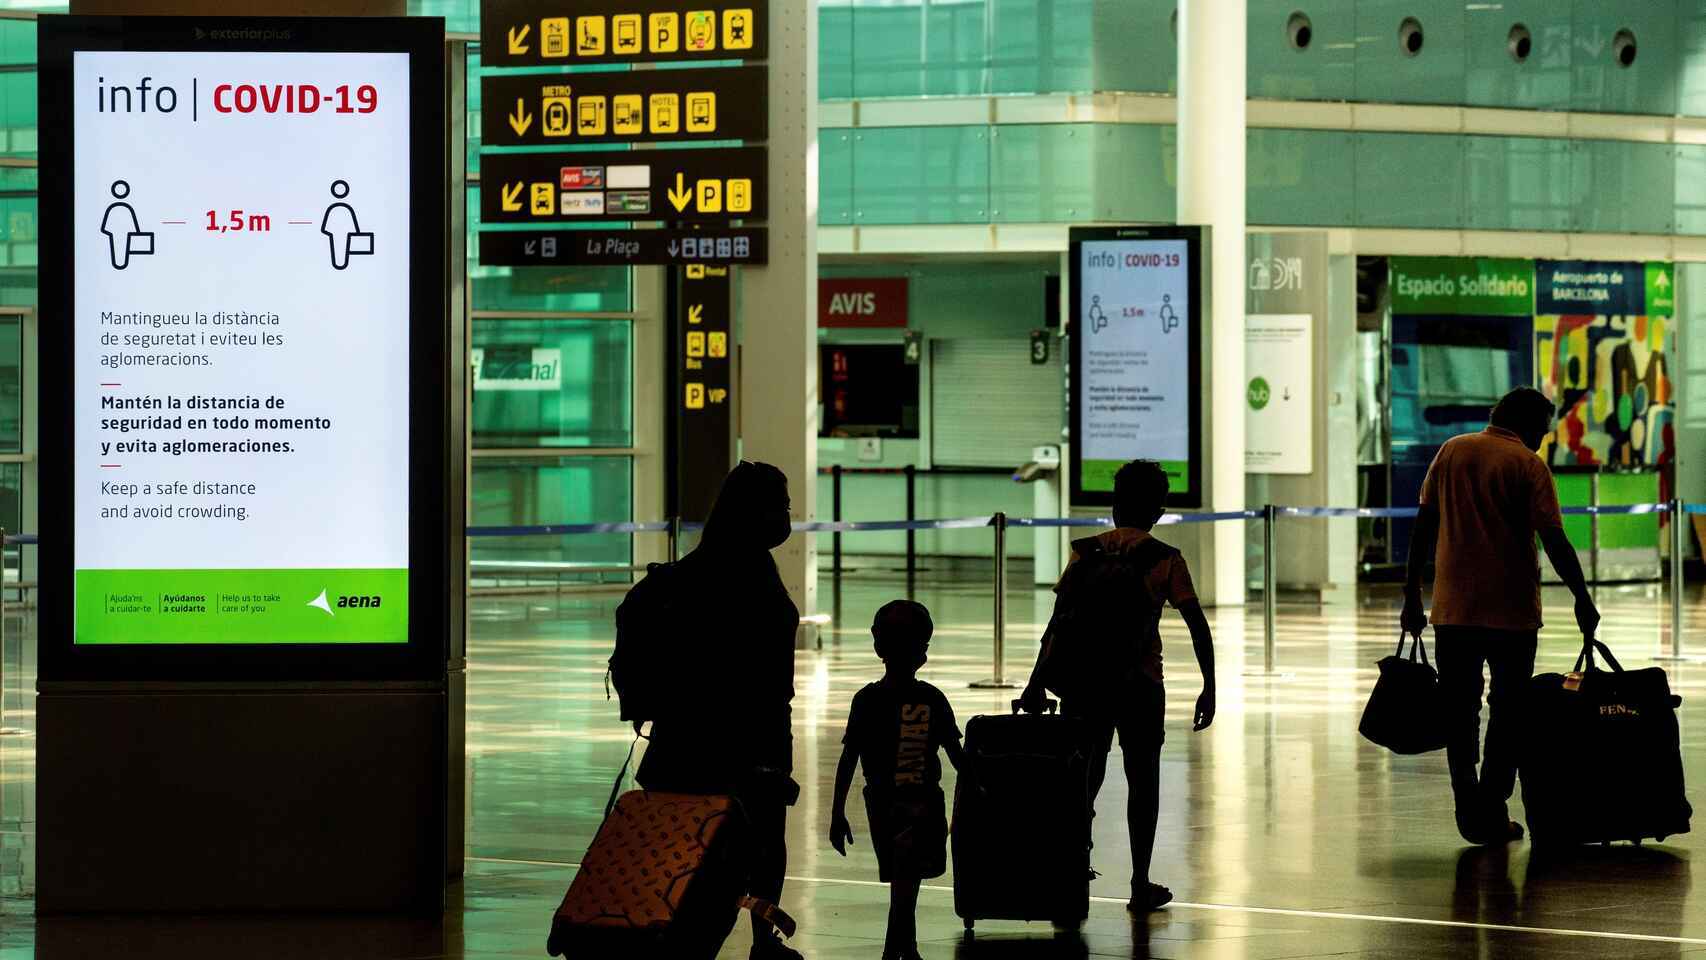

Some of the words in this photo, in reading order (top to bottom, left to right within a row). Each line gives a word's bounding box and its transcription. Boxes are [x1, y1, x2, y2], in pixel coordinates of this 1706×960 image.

[98, 77, 177, 113] info
[213, 84, 378, 114] COVID-19
[542, 85, 572, 98] METRO
[704, 186, 717, 208] P
[205, 210, 245, 234] 1,5
[249, 215, 271, 232] m
[586, 239, 602, 255] La
[605, 238, 640, 259] Plaça
[1087, 250, 1115, 268] info
[1125, 253, 1180, 268] COVID-19
[1610, 271, 1623, 284] de
[1397, 274, 1455, 301] Espacio
[1459, 273, 1529, 297] Solidario
[829, 292, 875, 315] AVIS
[100, 312, 190, 328] Mantingueu
[195, 311, 208, 326] la
[211, 310, 281, 326] distància
[99, 331, 119, 346] de
[123, 332, 196, 350] seguretat
[209, 331, 257, 346] eviteu
[262, 331, 284, 346] les
[906, 342, 919, 361] 4
[1034, 341, 1045, 360] 3
[100, 351, 213, 369] aglomeracions.
[101, 394, 163, 410] Mantén
[167, 394, 182, 410] la
[186, 394, 260, 410] distancia
[264, 394, 285, 410] de
[708, 388, 727, 403] VIP
[101, 415, 182, 433] seguridad
[187, 418, 208, 430] en
[211, 415, 250, 430] todo
[254, 416, 331, 430] momento
[101, 442, 112, 456] y
[115, 438, 157, 454] evita
[161, 438, 295, 456] aglomeraciones.
[101, 480, 139, 499] Keep
[142, 483, 152, 496] a
[155, 480, 189, 496] safe
[192, 480, 257, 496] distance
[100, 504, 129, 519] and
[133, 504, 173, 519] avoid
[177, 504, 250, 521] crowding.
[163, 592, 206, 604] Ayúdanos
[222, 593, 240, 604] Help
[252, 594, 261, 602] to
[264, 593, 281, 602] take
[336, 595, 381, 608] aena
[117, 604, 152, 613] cuidar-te
[170, 604, 206, 613] cuidarte
[241, 604, 249, 613] of
[251, 606, 266, 615] you
